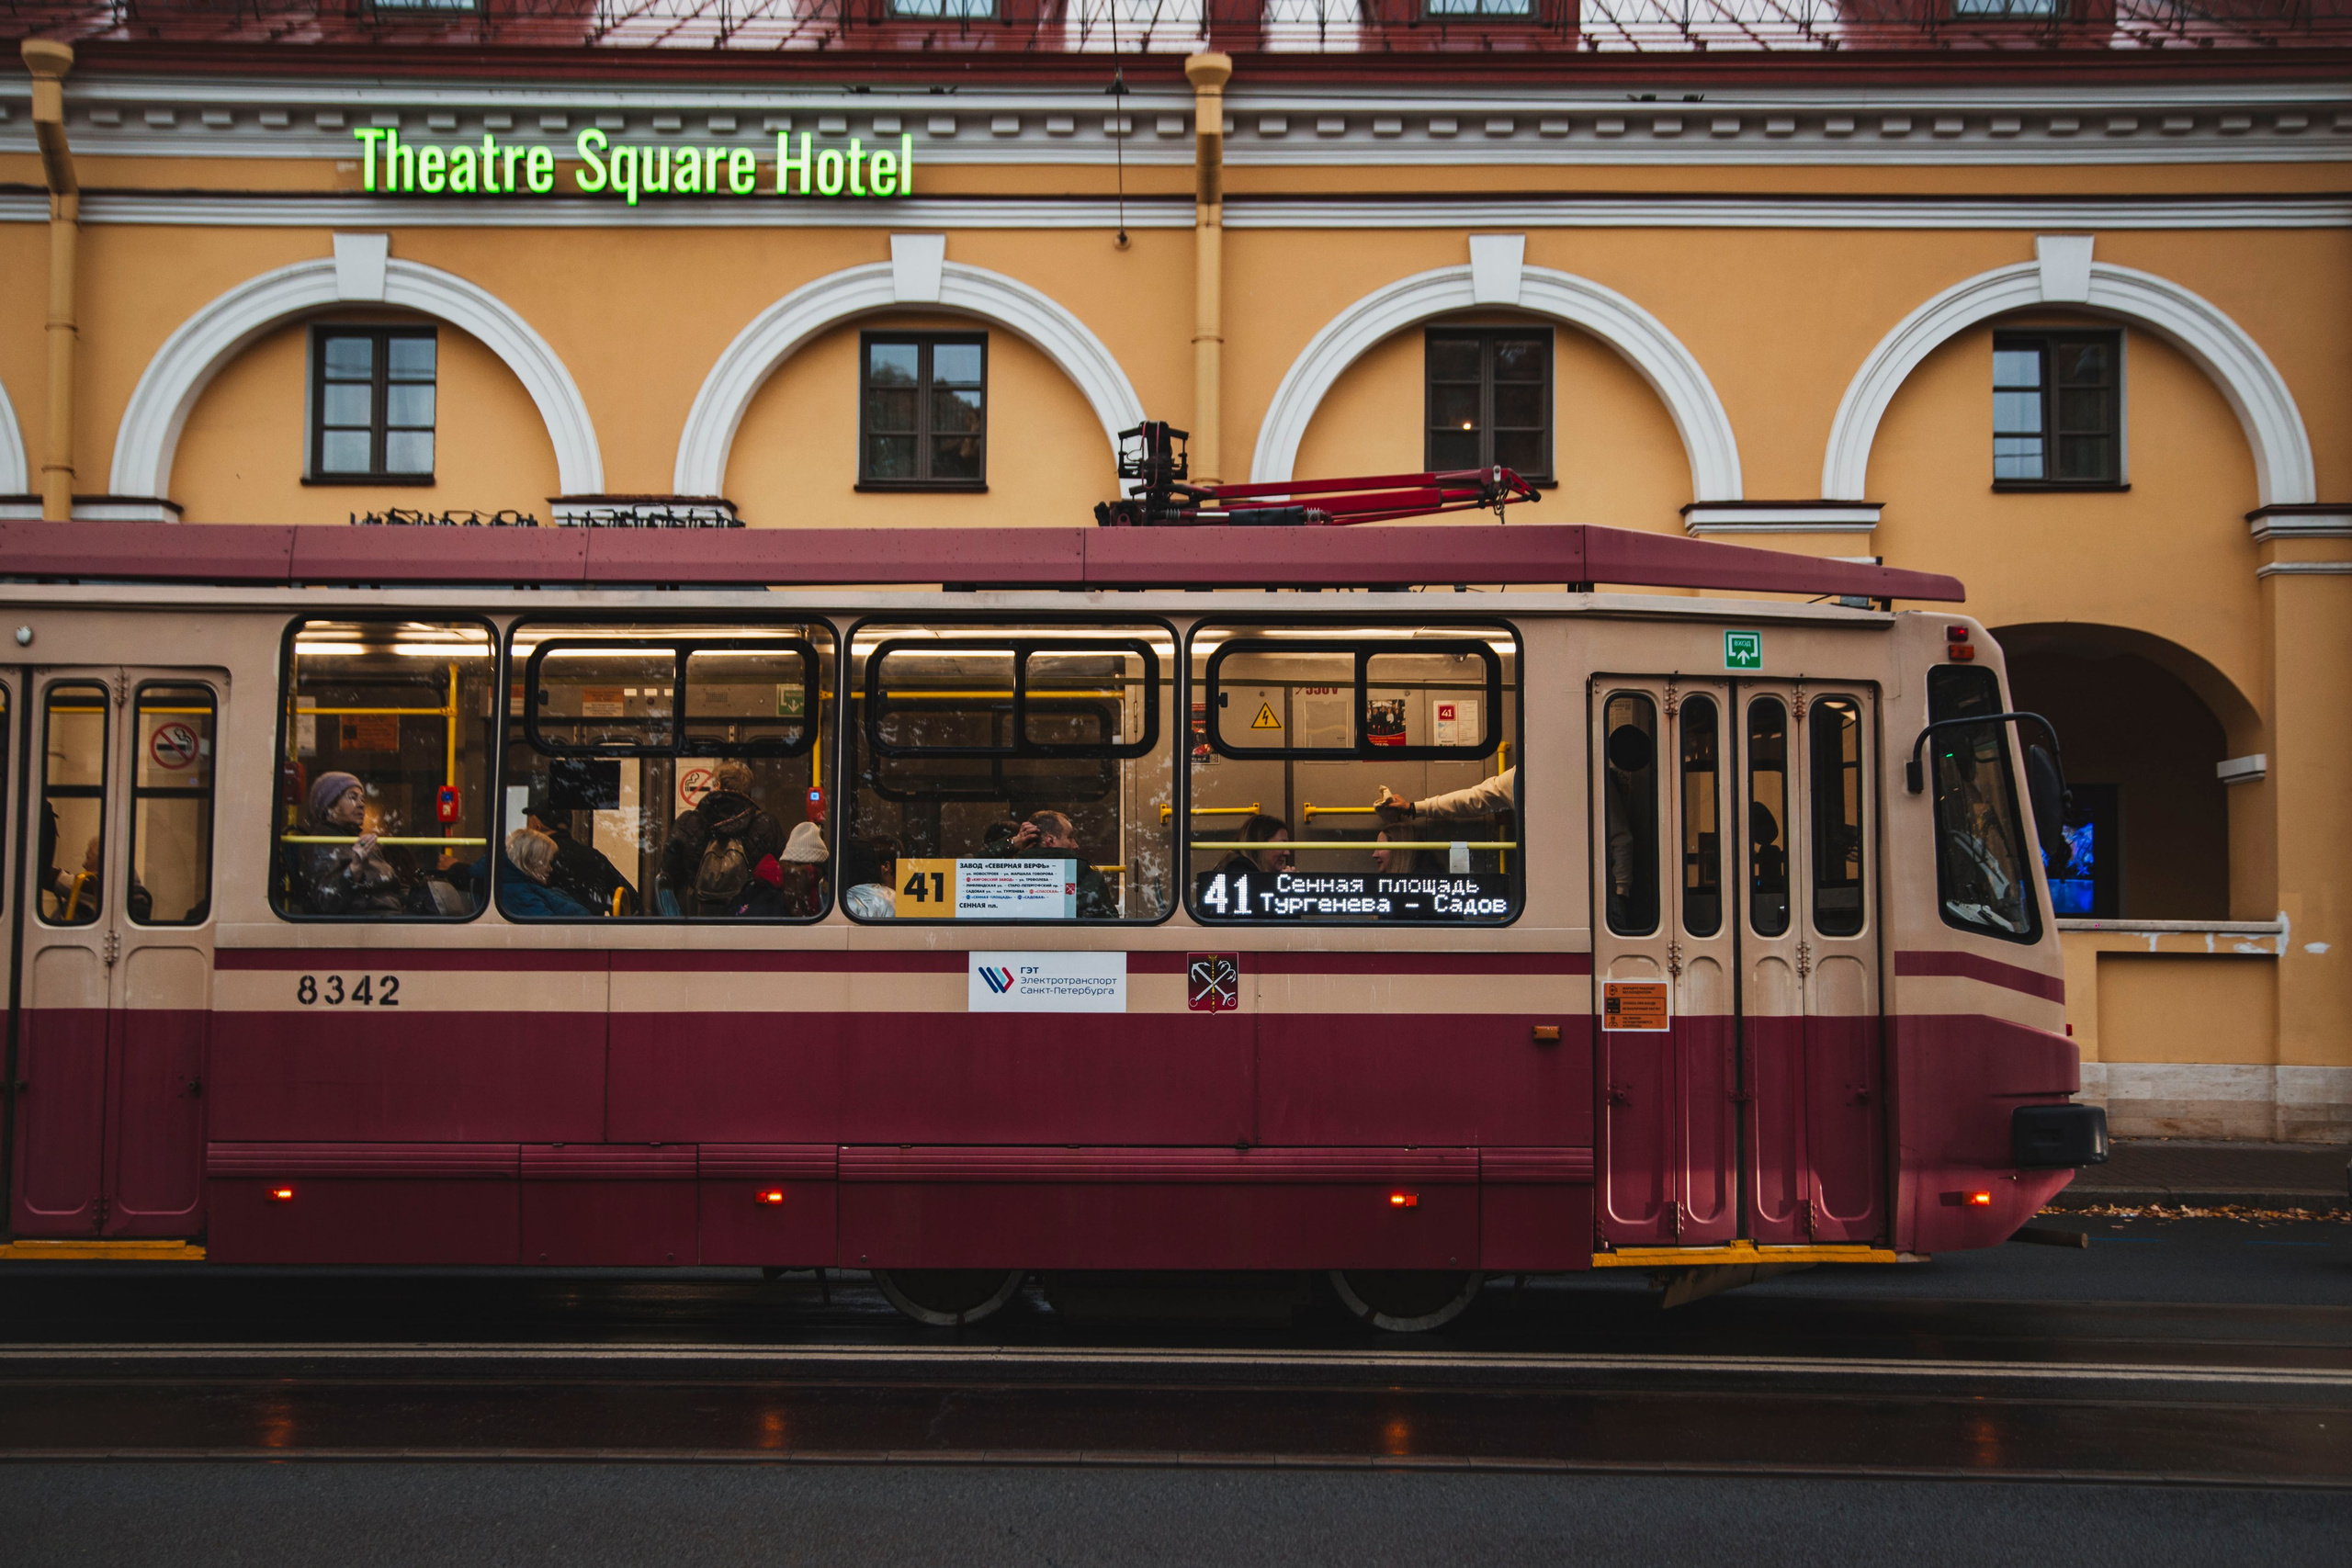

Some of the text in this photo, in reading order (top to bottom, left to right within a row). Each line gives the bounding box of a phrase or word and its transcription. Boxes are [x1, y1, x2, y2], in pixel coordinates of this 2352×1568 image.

[354, 127, 914, 207] Theatre Square Hotel
[1441, 708, 1453, 717] 41
[903, 872, 944, 902] 41
[1204, 874, 1252, 914] 41
[1276, 874, 1479, 896] Сенная площадь
[1260, 892, 1391, 914] Тургенева
[1433, 894, 1507, 914] Садов
[297, 975, 400, 1006] 8342
[1020, 976, 1117, 986] Электротранспорт
[1020, 986, 1114, 996] Санкт-Петербурга
